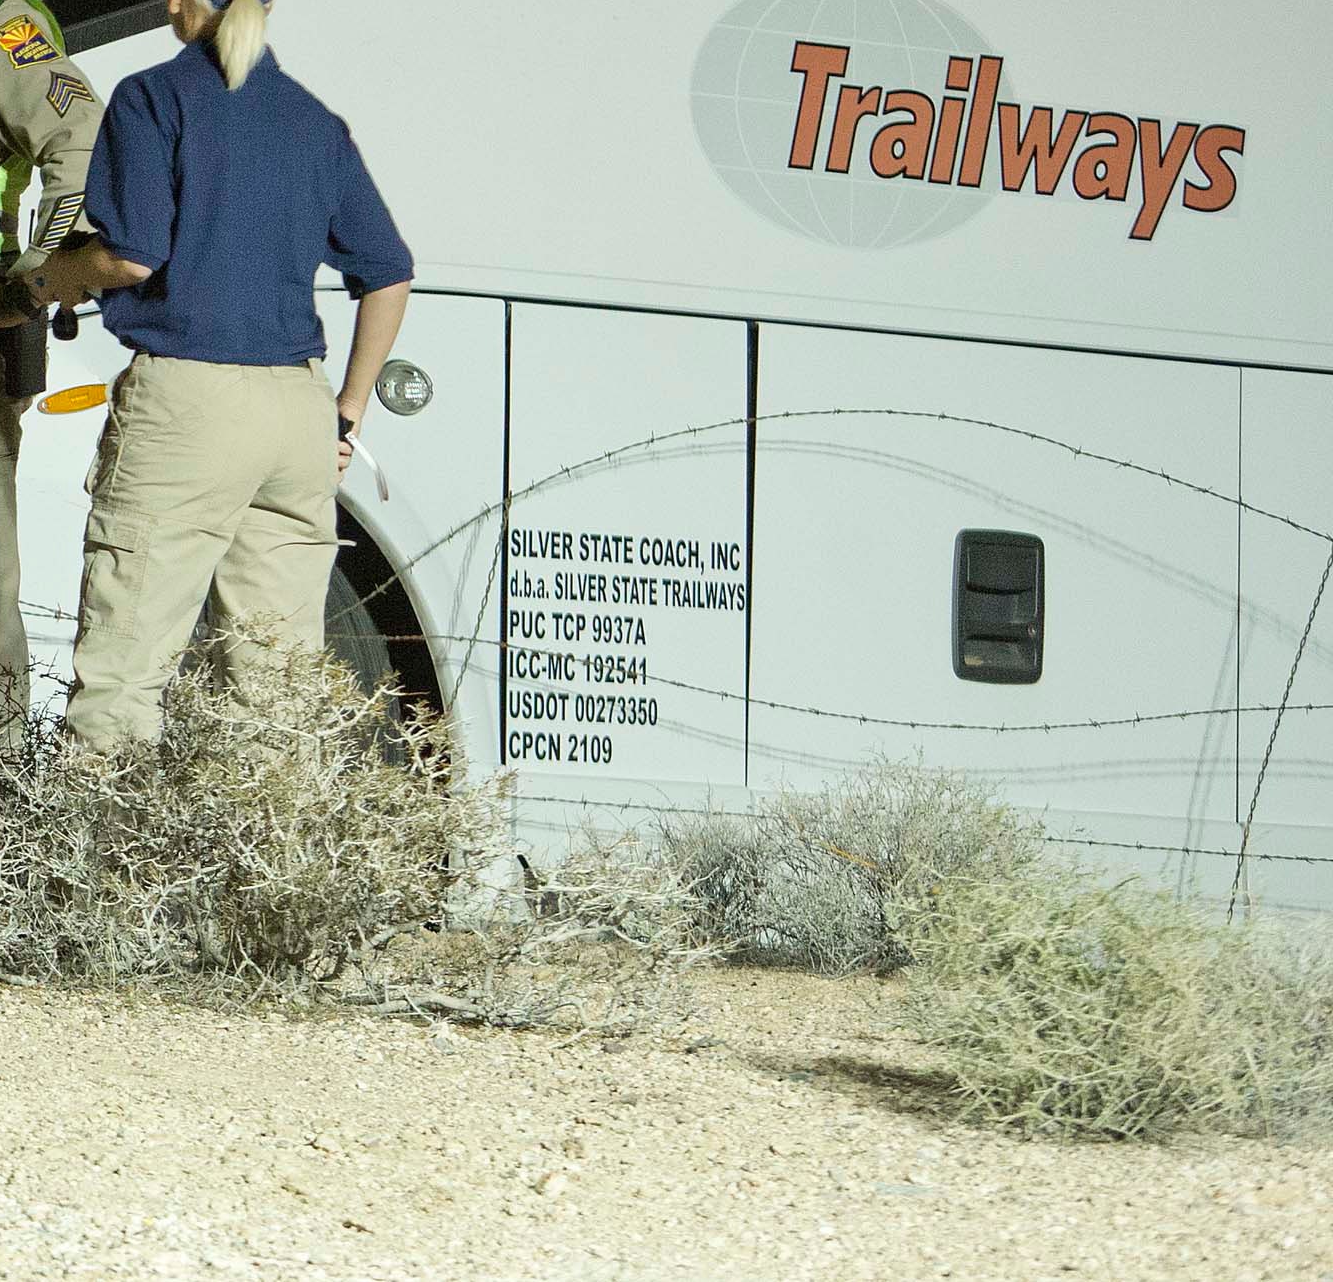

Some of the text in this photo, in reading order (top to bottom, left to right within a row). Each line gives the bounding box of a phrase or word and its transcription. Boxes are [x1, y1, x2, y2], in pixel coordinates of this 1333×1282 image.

[788, 40, 1245, 240] Trailways
[510, 528, 741, 575] SILVER STATE COACH, INC
[509, 571, 746, 611] d.b.a. SILVER STATE TRAILWAYS
[509, 609, 647, 646] PUC TCP 9937A
[509, 649, 648, 686] ICC-MC 192541
[509, 690, 658, 726] USDOT 00273350
[509, 731, 613, 764] CPCN 2109
